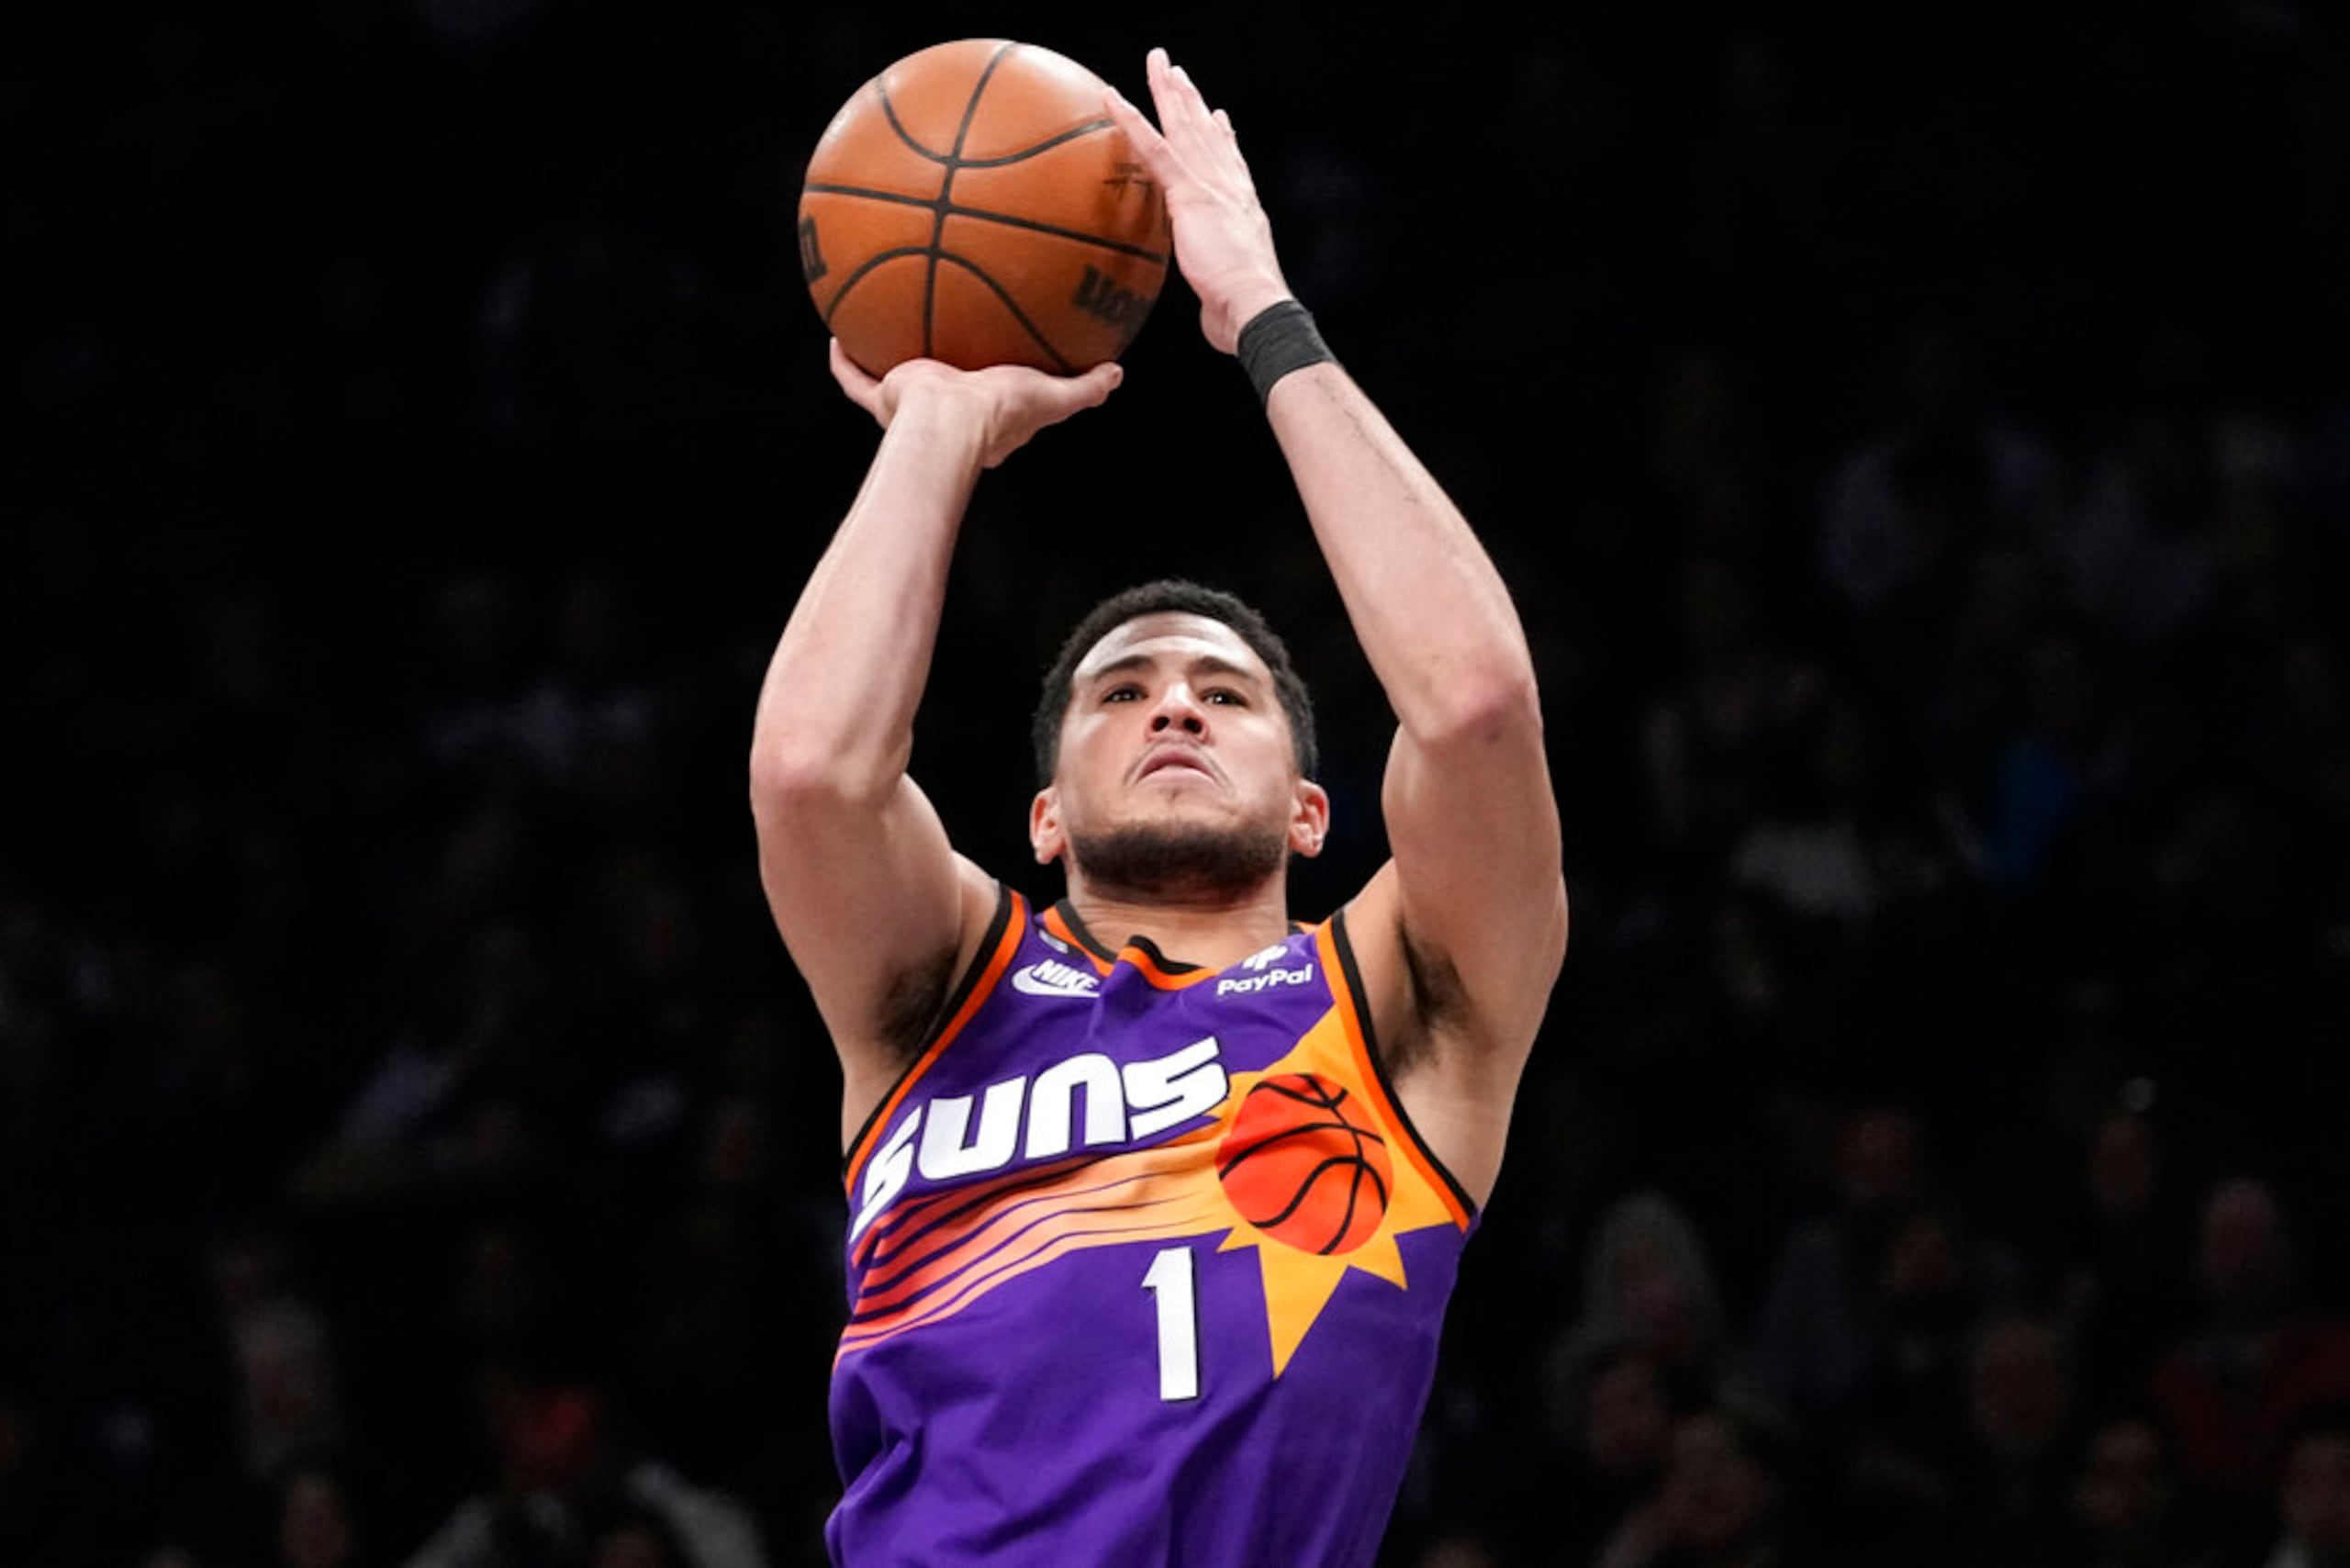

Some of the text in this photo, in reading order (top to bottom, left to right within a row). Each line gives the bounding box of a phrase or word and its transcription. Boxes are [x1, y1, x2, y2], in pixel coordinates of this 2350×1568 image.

[1031, 958, 1100, 992] NIKE
[1216, 963, 1314, 996] PayPal
[1140, 1246, 1200, 1403] 1
